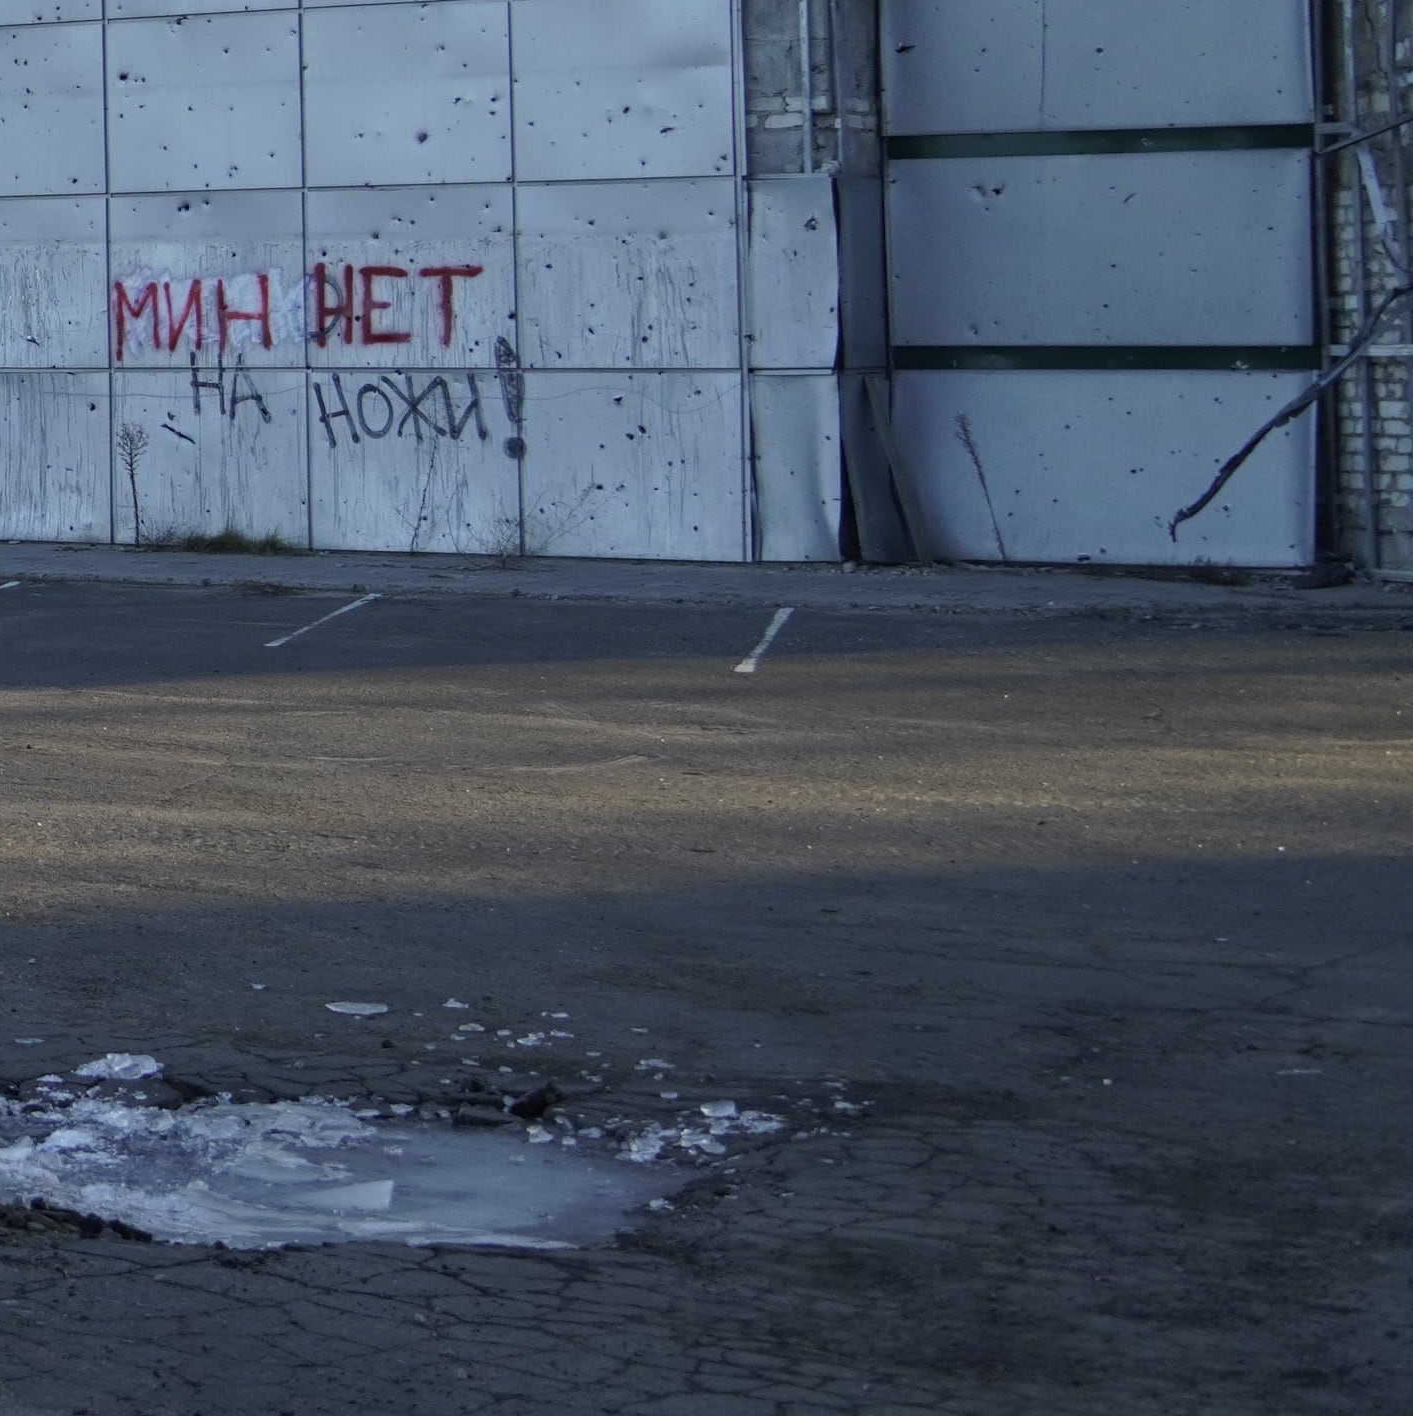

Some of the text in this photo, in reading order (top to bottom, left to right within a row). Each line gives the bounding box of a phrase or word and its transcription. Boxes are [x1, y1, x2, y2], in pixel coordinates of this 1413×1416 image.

[114, 261, 485, 361] МИН НЕТ
[189, 350, 272, 424] НА
